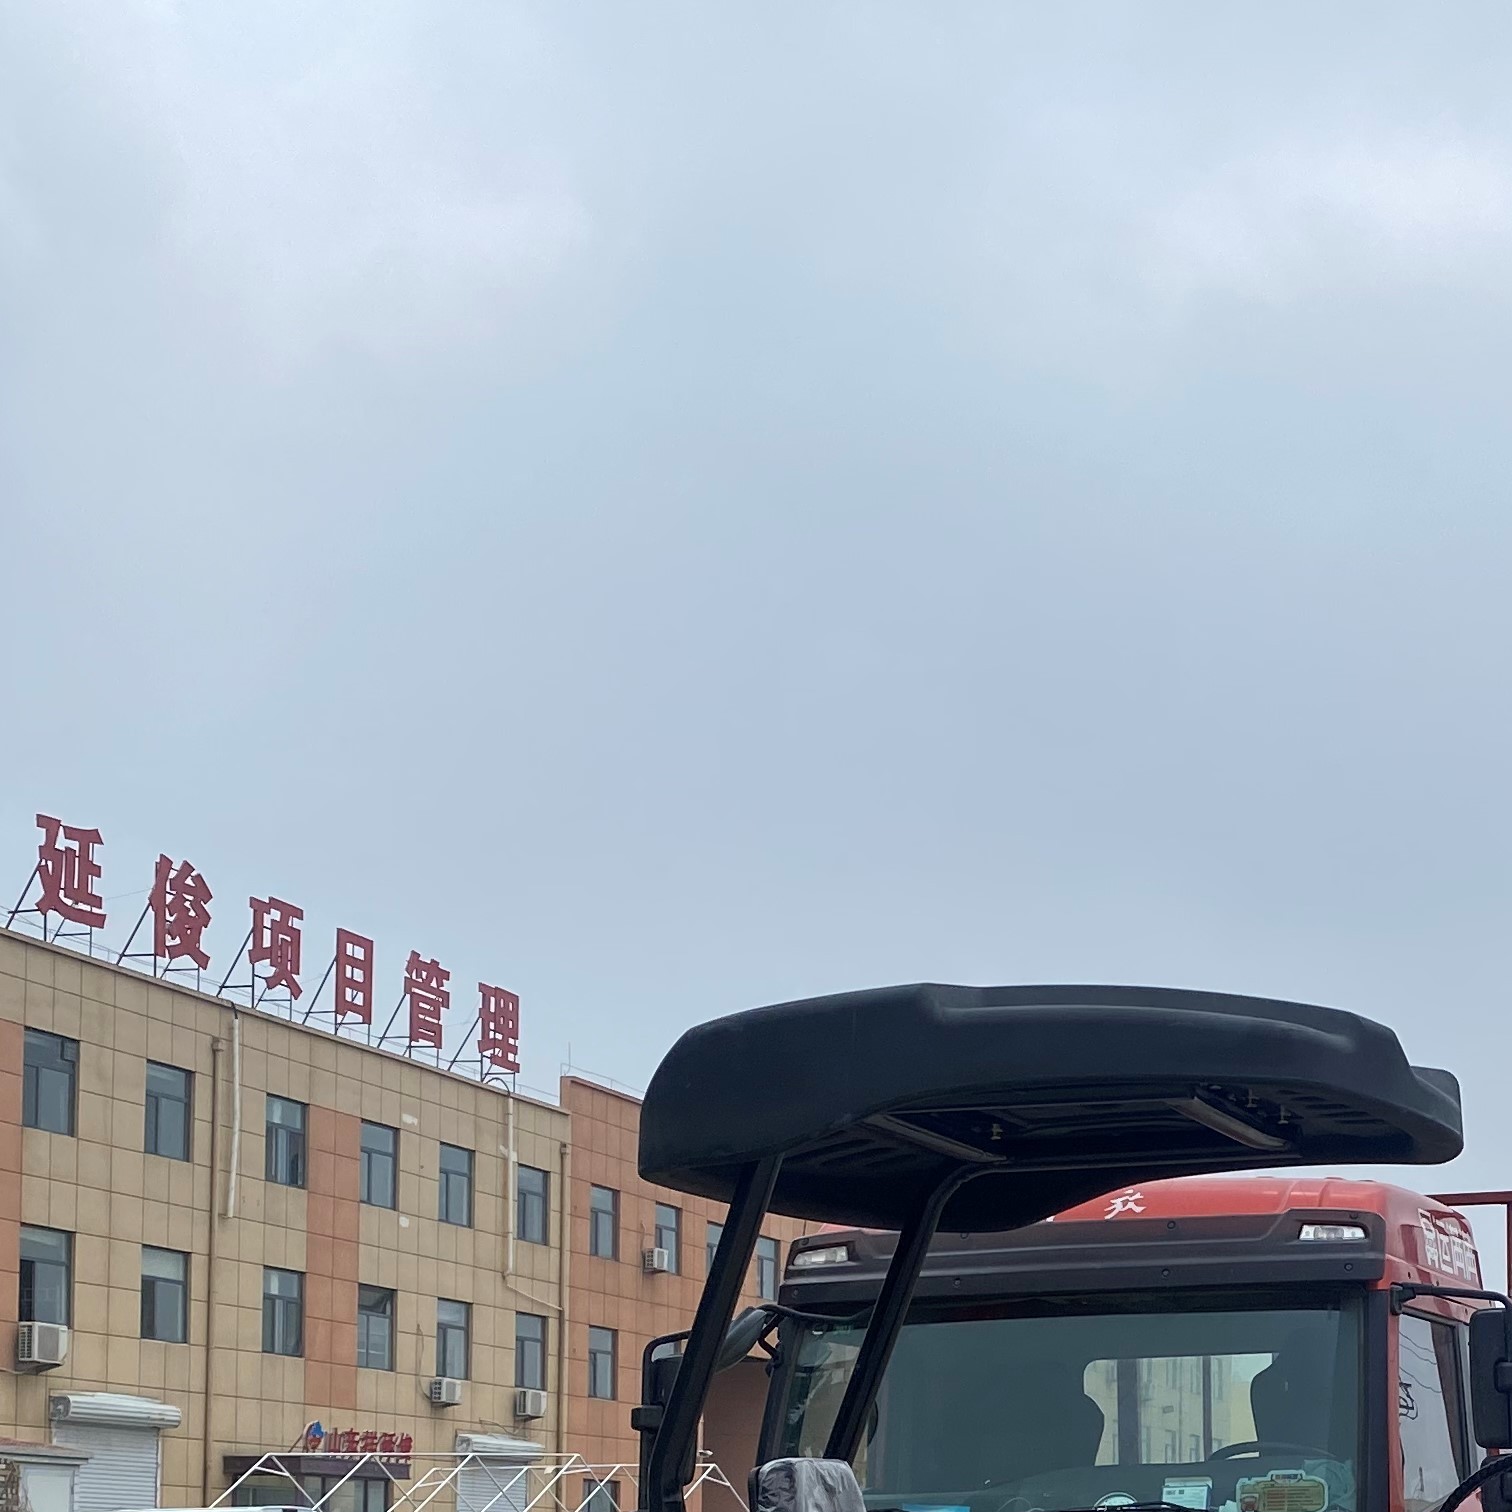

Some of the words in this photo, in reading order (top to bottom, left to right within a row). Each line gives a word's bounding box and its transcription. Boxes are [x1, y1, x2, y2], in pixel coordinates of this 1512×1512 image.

[36, 814, 520, 1073] 延俊项目管理
